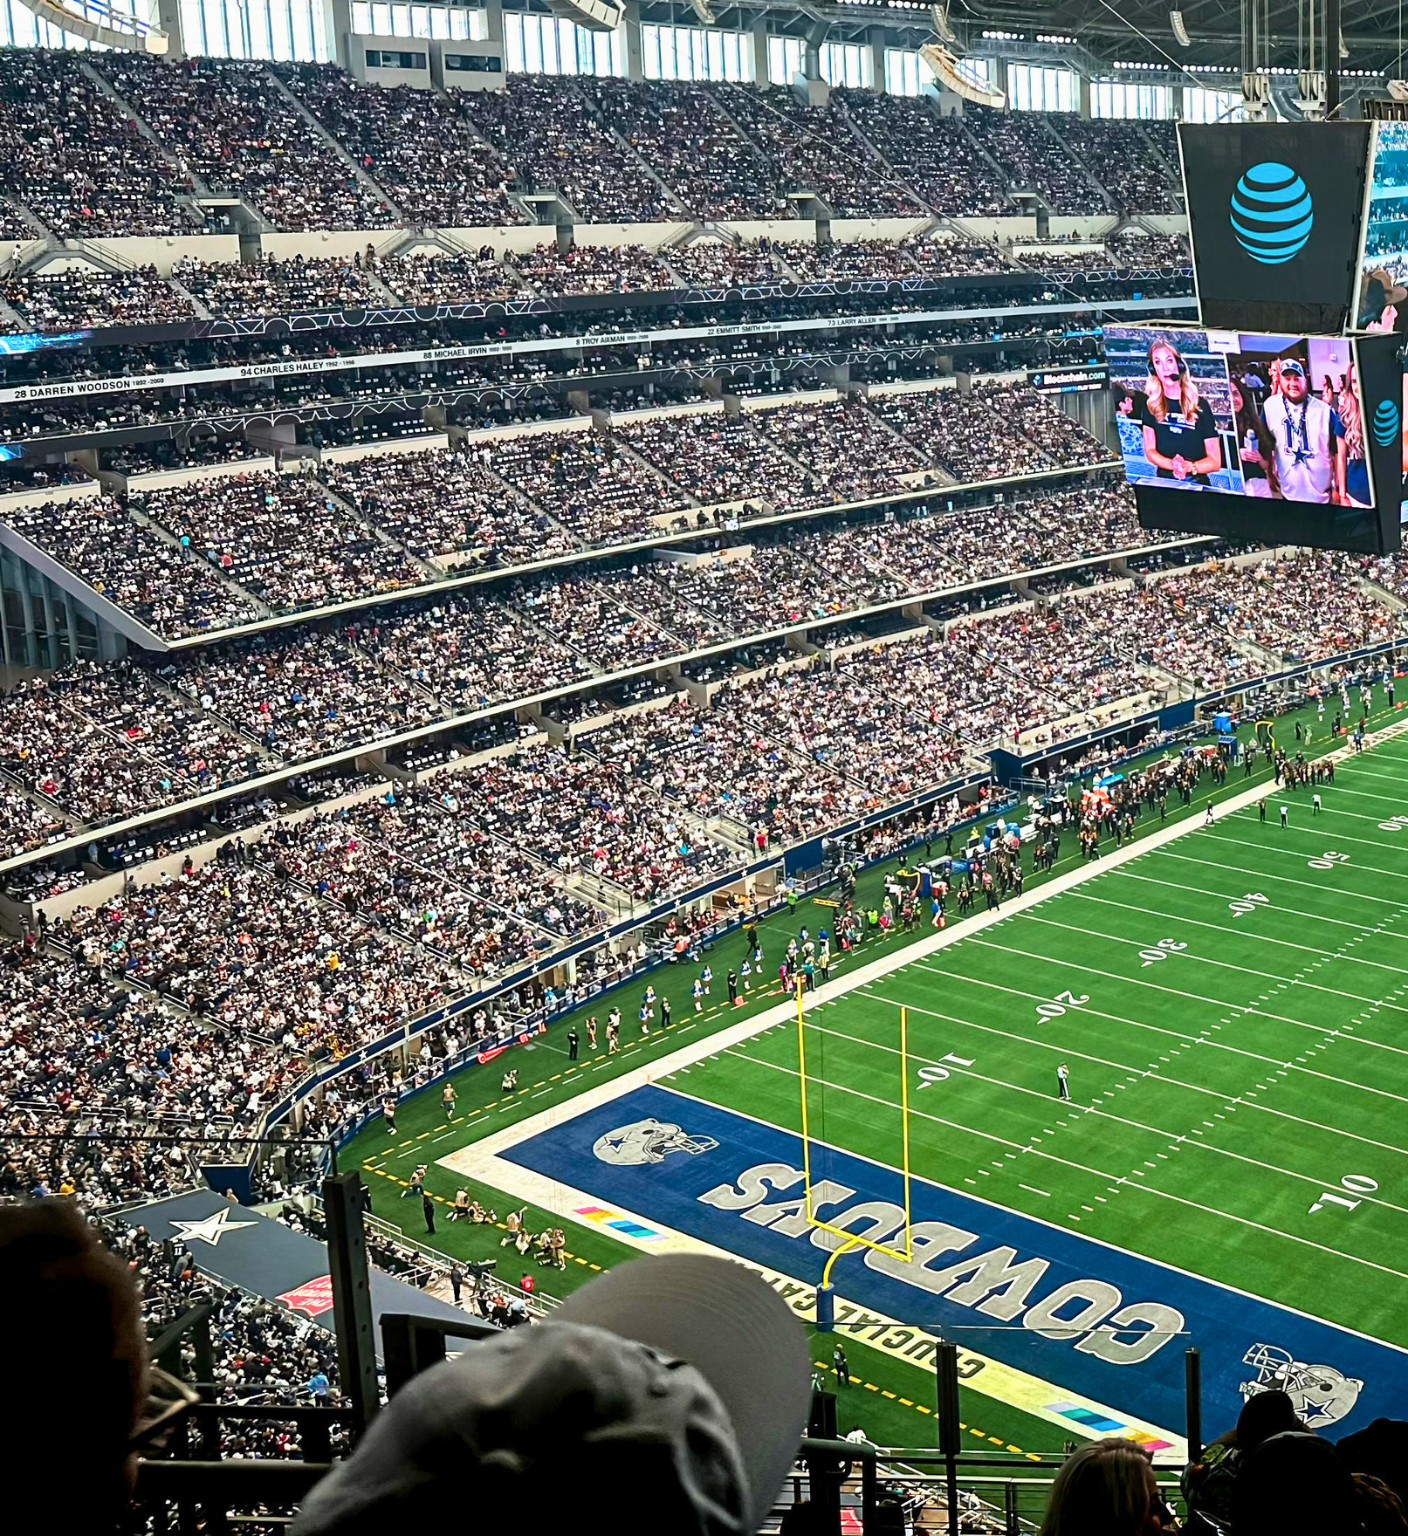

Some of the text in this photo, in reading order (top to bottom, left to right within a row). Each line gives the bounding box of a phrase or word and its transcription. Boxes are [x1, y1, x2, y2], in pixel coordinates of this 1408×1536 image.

[858, 316, 876, 324] ALLEN
[716, 326, 740, 334] EMMITT
[742, 325, 761, 333] SMITH
[582, 337, 599, 345] TROY
[600, 335, 625, 343] AIKMAN
[423, 352, 432, 360] 88
[434, 349, 467, 359] MICHAEL
[468, 347, 487, 356] IRVIN
[240, 368, 253, 377] 94
[254, 364, 295, 375] CHARLES
[296, 362, 324, 371] HALEY
[1043, 371, 1106, 385] Blockchain.com
[14, 389, 27, 399] 28
[30, 385, 74, 398] DARREN
[78, 380, 130, 393] WOODSON
[1307, 851, 1350, 869] 50
[1228, 893, 1270, 912] 40
[1138, 938, 1188, 961] 30
[1035, 990, 1090, 1017] 20
[917, 1052, 976, 1081] 10
[1318, 1174, 1379, 1212] 10
[697, 1164, 1185, 1365] COWBOYS
